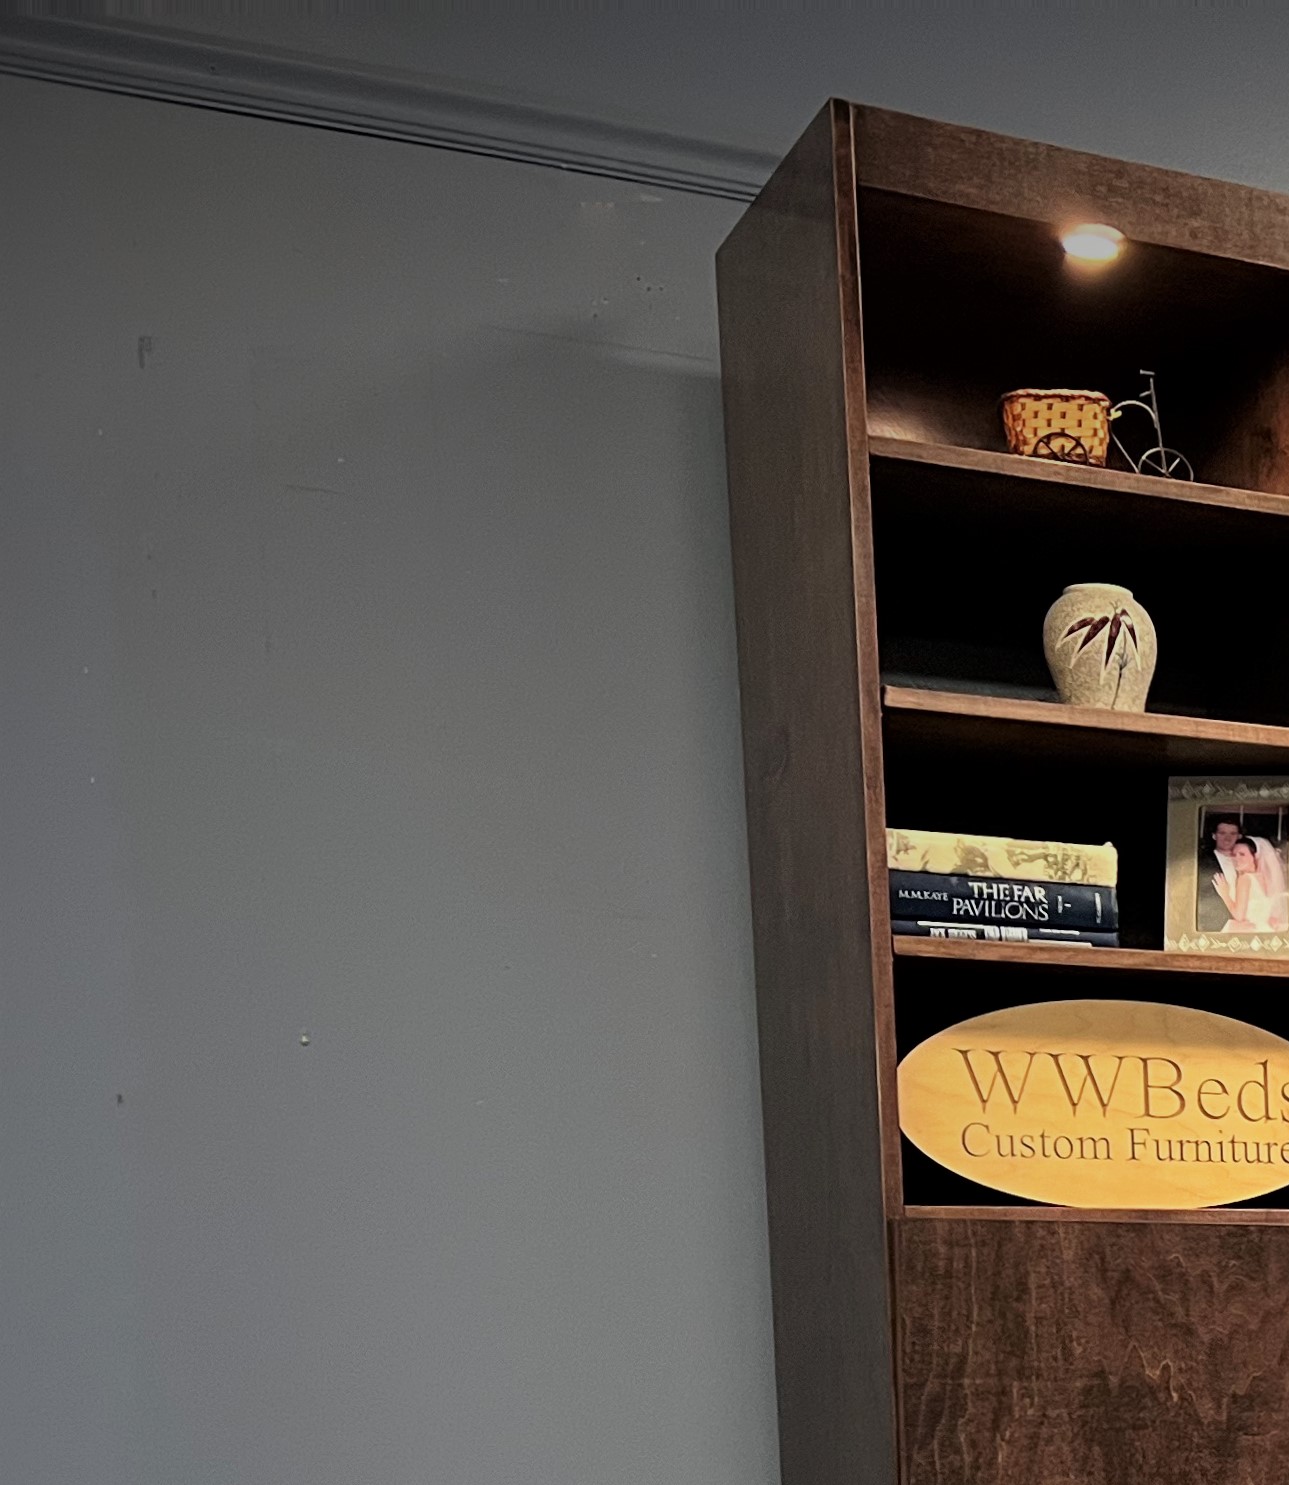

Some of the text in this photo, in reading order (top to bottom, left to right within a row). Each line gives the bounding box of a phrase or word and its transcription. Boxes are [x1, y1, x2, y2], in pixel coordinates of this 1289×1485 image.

[967, 881, 1048, 904] THE FAR
[952, 898, 1049, 921] PAVILIONS
[960, 1122, 1114, 1161] Custom
